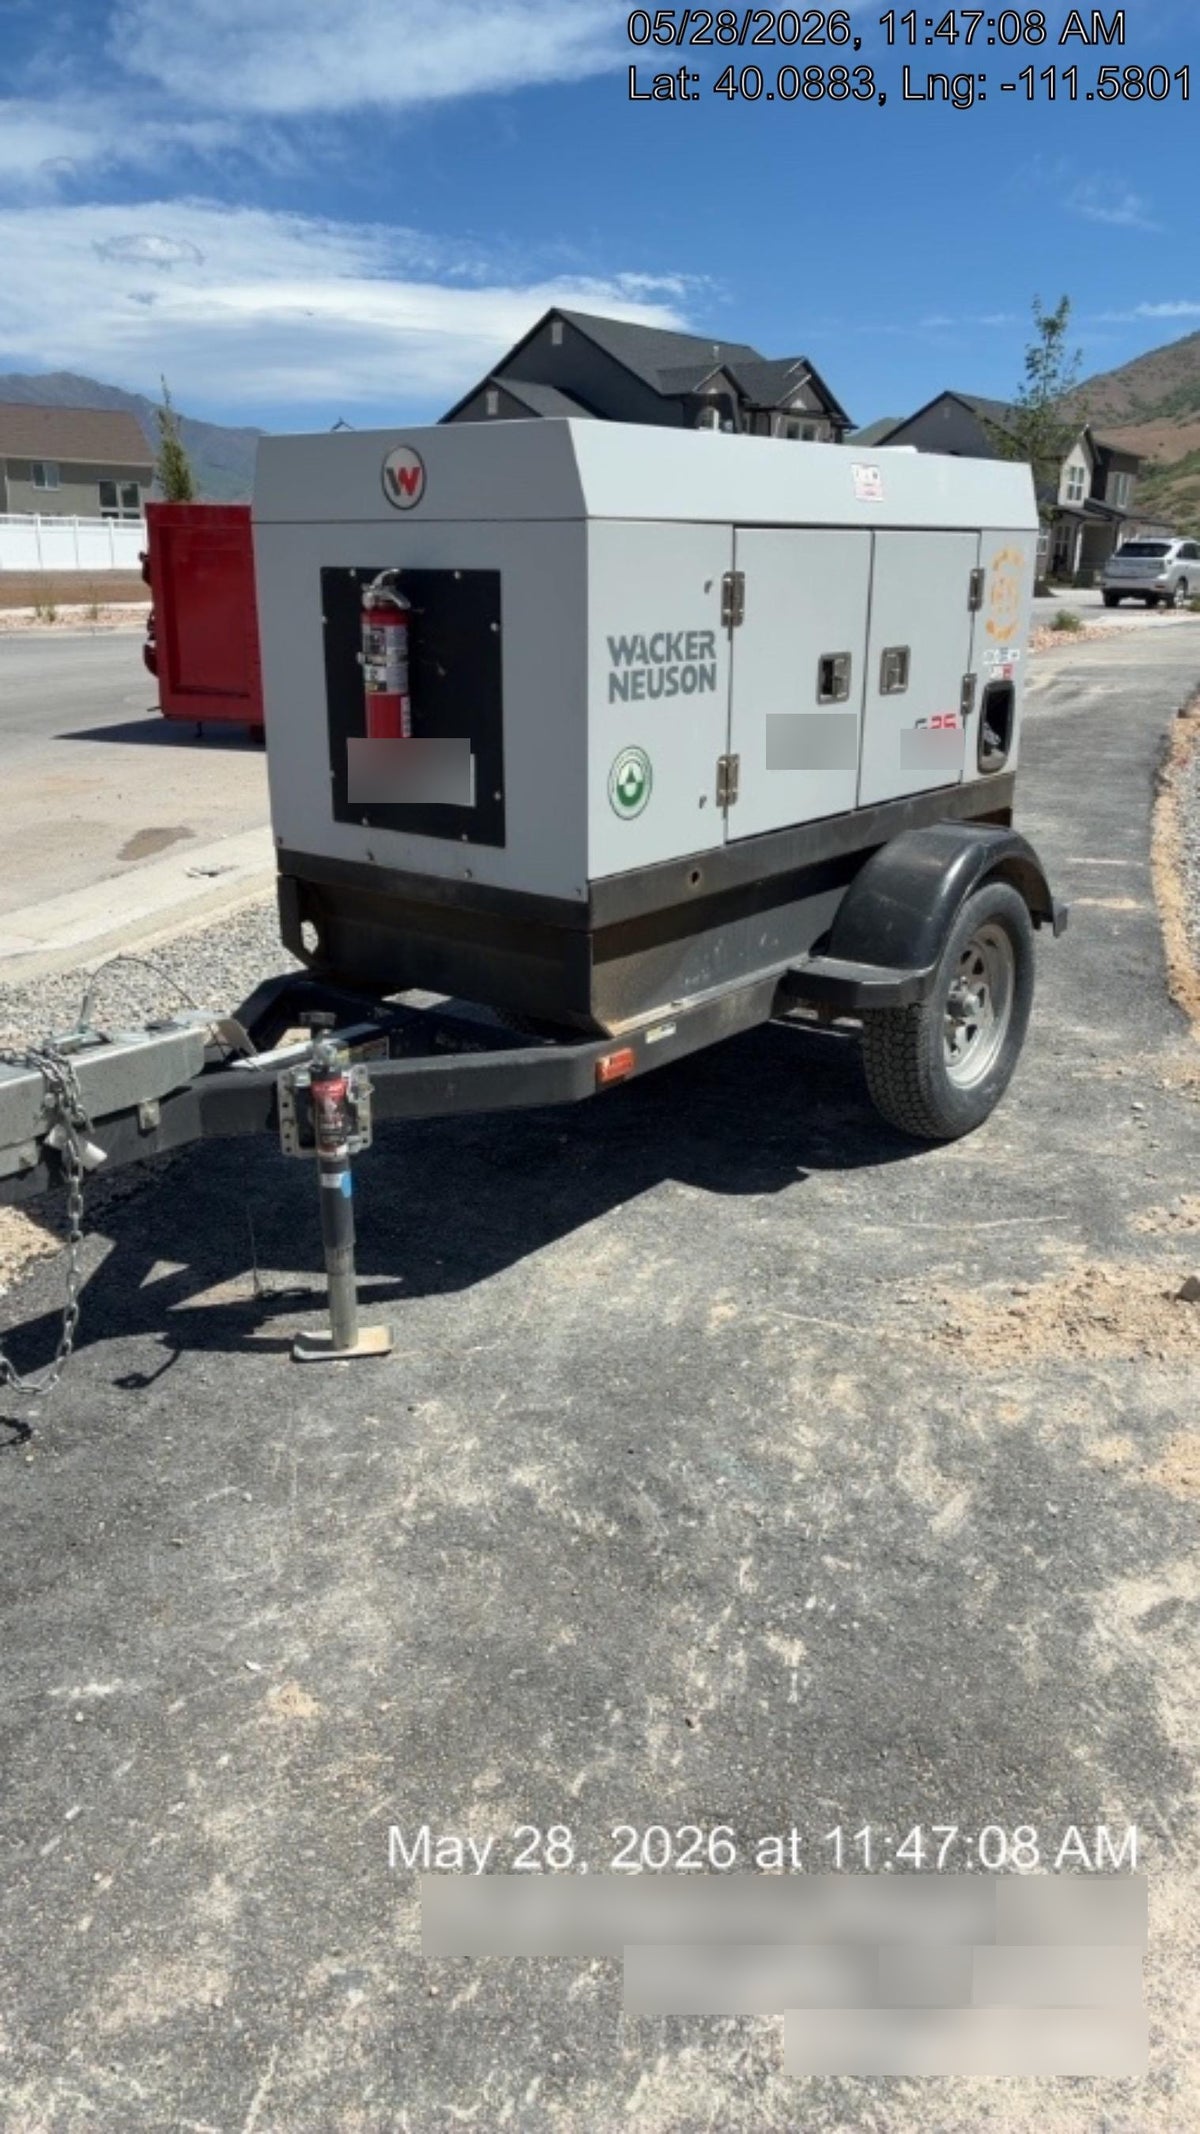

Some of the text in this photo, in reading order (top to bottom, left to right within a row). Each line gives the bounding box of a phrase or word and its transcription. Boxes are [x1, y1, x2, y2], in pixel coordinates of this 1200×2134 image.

[386, 467, 420, 496] W
[606, 630, 717, 667] WACKER
[608, 662, 717, 704] NEUSON
